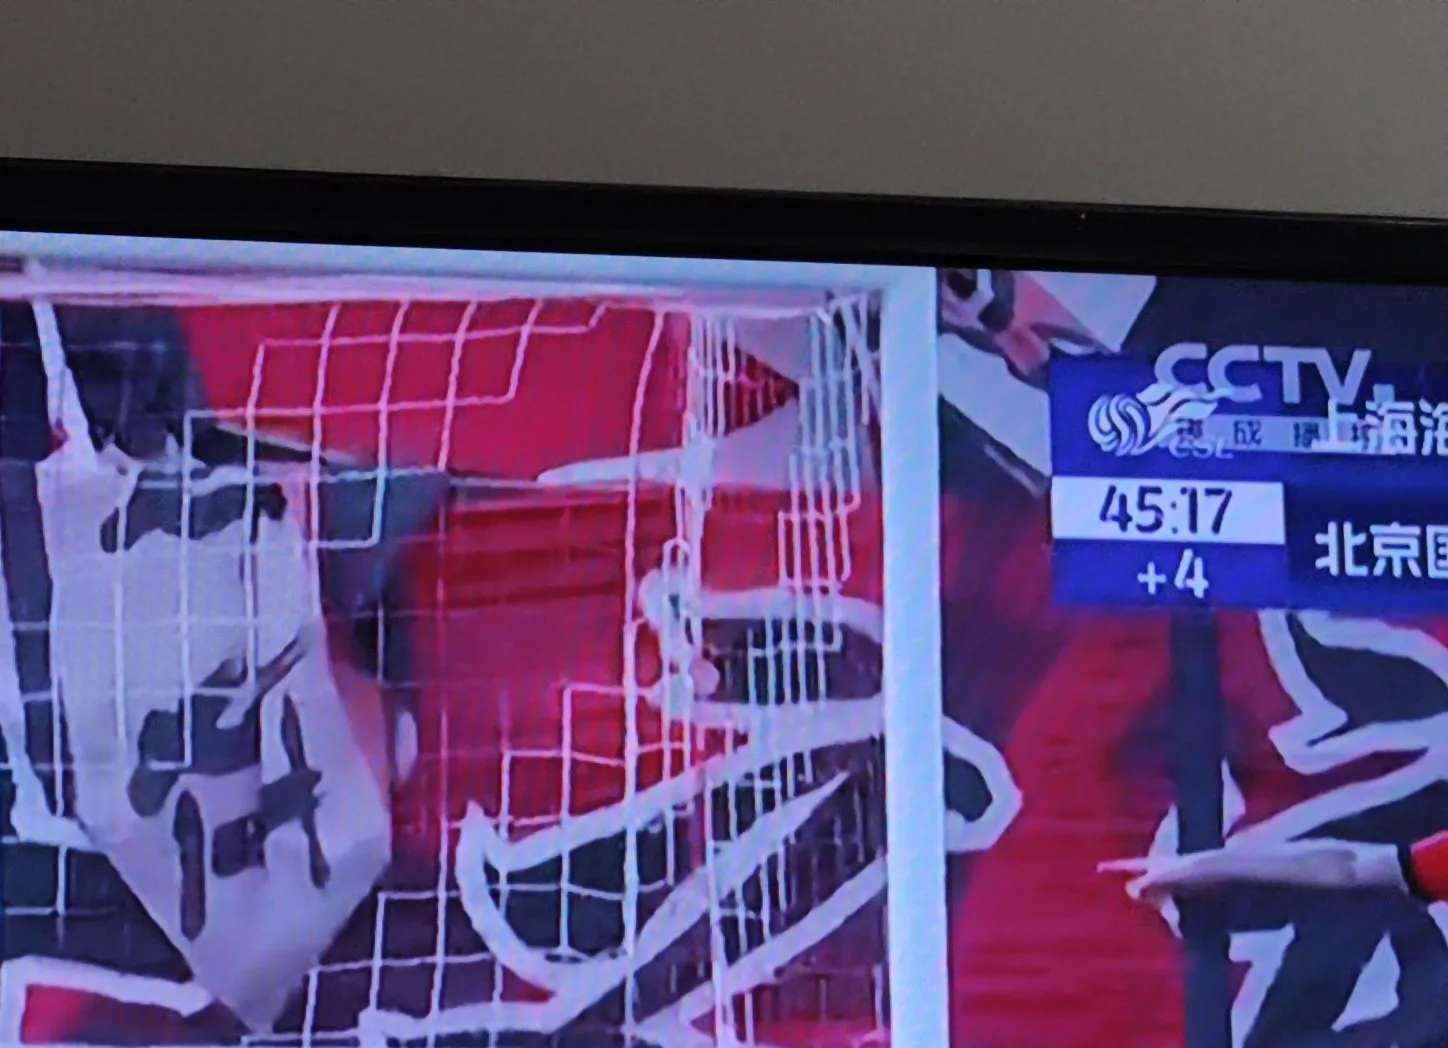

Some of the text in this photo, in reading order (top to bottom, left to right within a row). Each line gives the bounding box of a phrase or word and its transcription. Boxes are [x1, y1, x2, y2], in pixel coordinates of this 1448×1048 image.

[1154, 342, 1372, 405] CCTV
[1099, 485, 1234, 535] 45:17
[1136, 547, 1210, 599] +4
